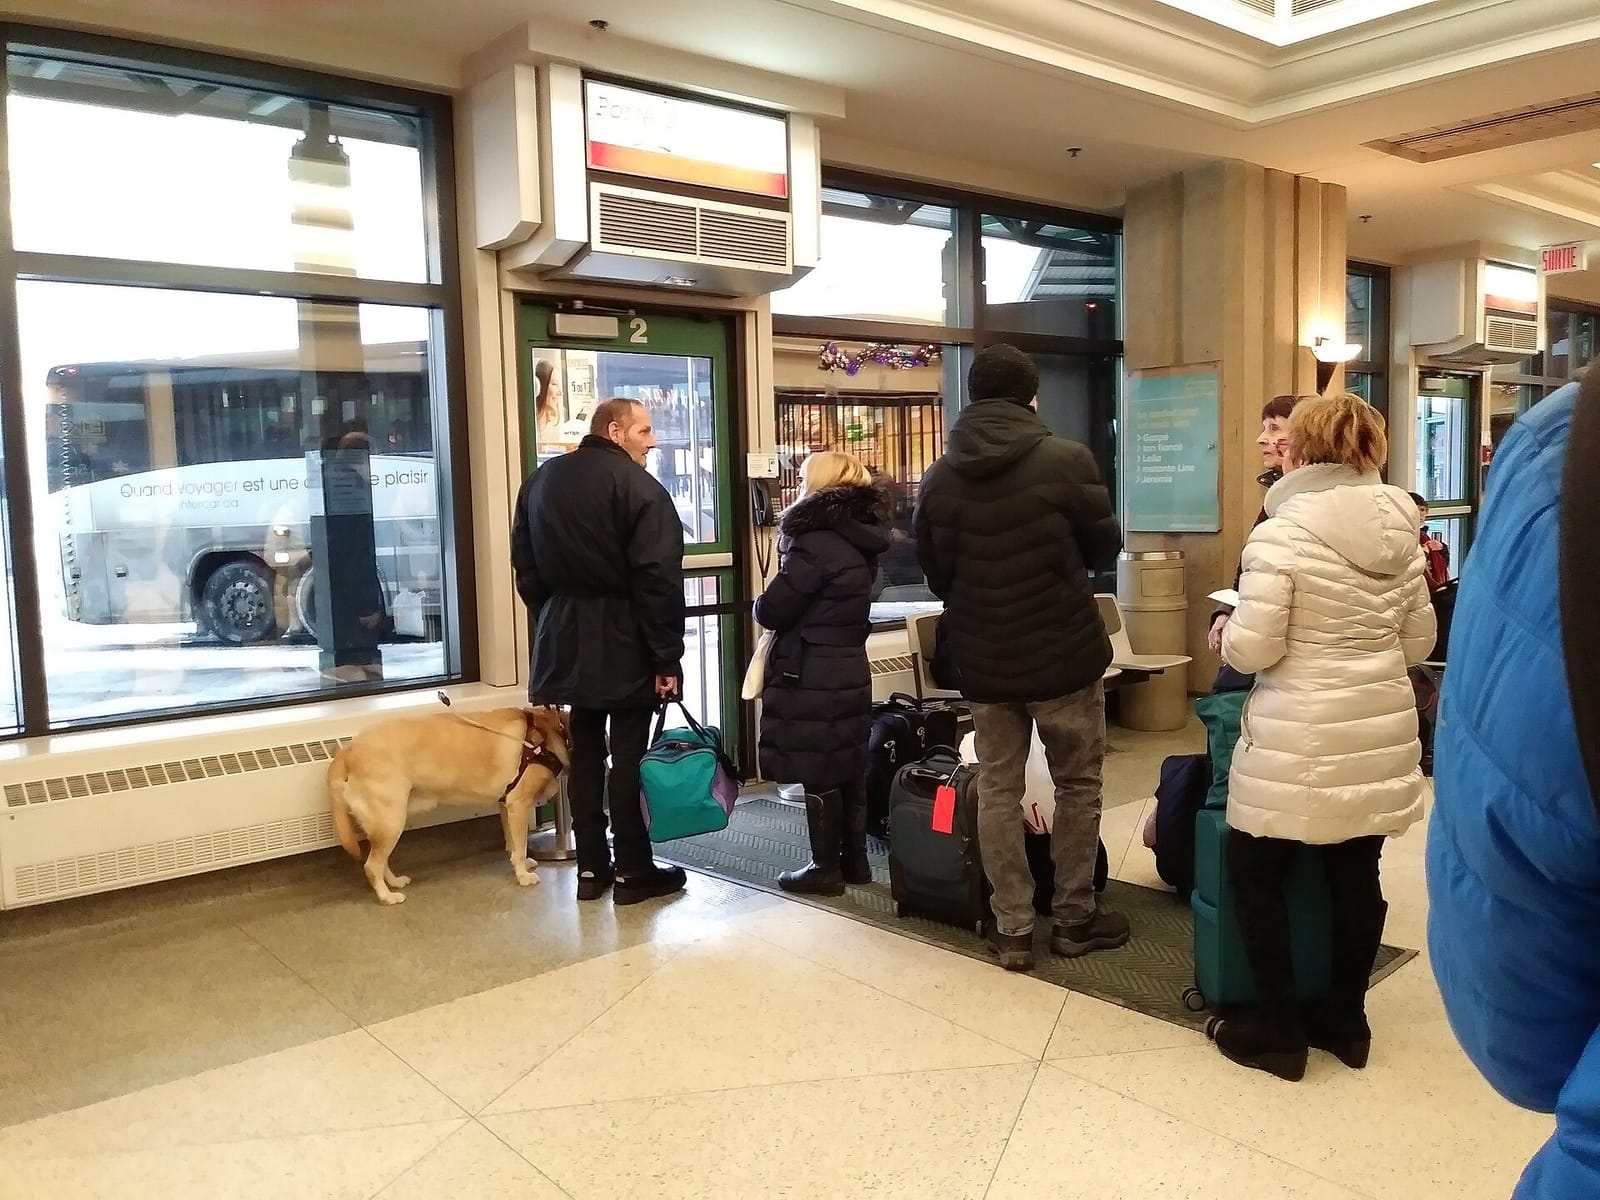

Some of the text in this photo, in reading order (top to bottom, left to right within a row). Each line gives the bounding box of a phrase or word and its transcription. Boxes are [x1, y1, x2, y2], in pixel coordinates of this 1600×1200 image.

[629, 317, 648, 343] 2
[120, 482, 172, 498] Quand
[178, 480, 238, 497] voyager
[243, 477, 265, 492] est
[269, 478, 298, 491] une
[385, 469, 428, 488] plaisir
